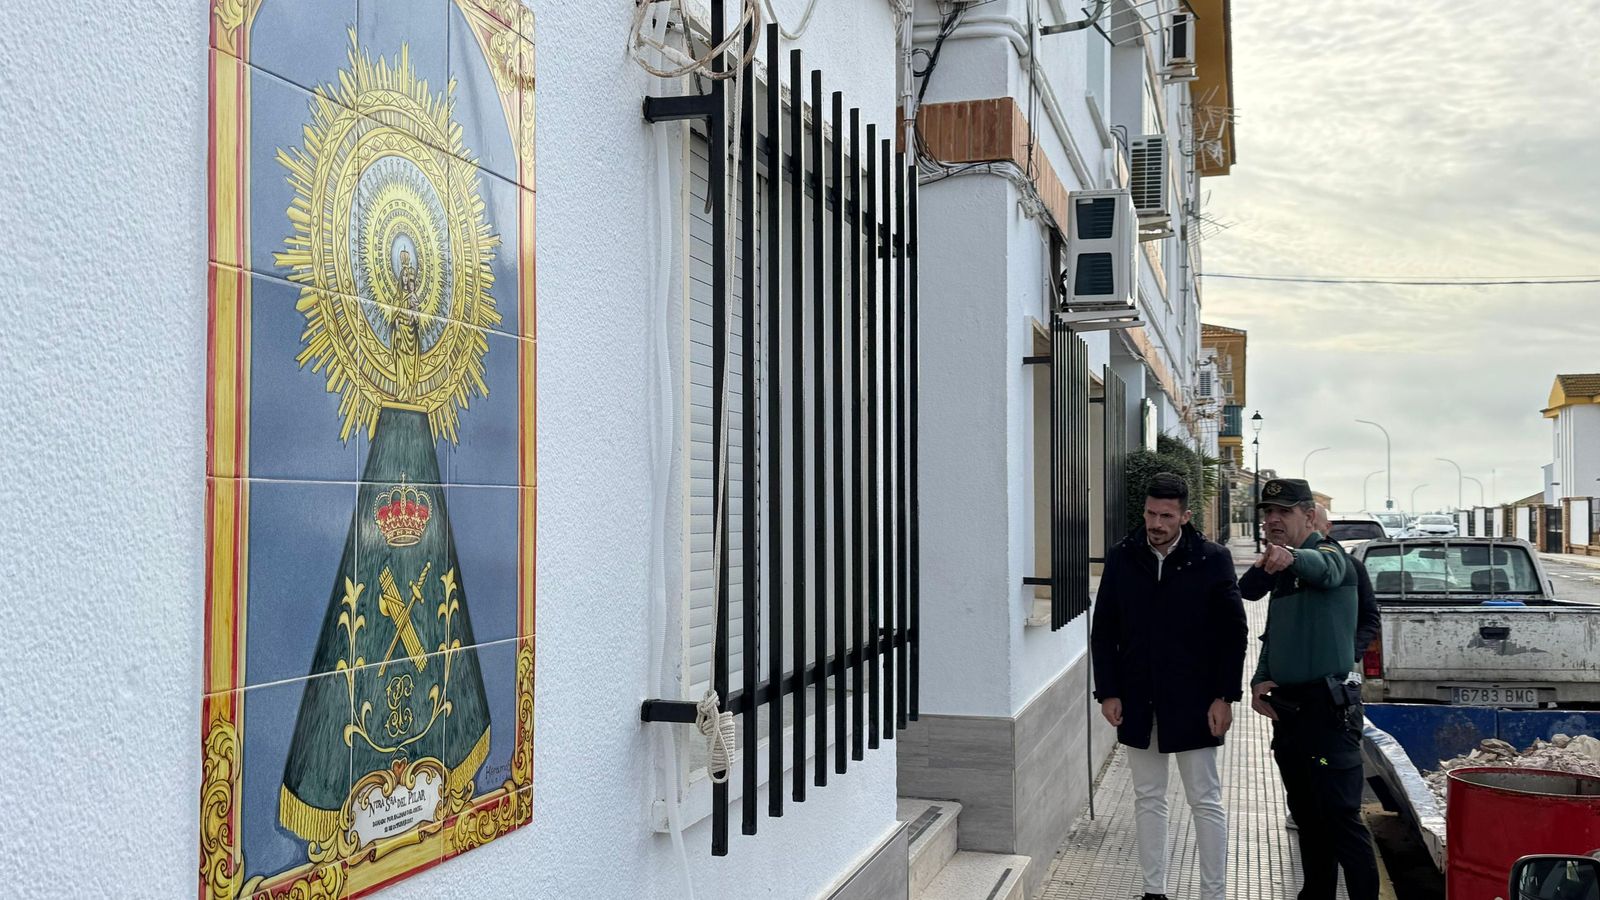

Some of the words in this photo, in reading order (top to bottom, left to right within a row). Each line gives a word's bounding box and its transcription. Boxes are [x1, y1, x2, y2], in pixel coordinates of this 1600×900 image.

[1461, 689, 1499, 702] 6783
[1505, 689, 1534, 703] BMC
[397, 797, 406, 808] DEL
[408, 790, 426, 805] PILAR
